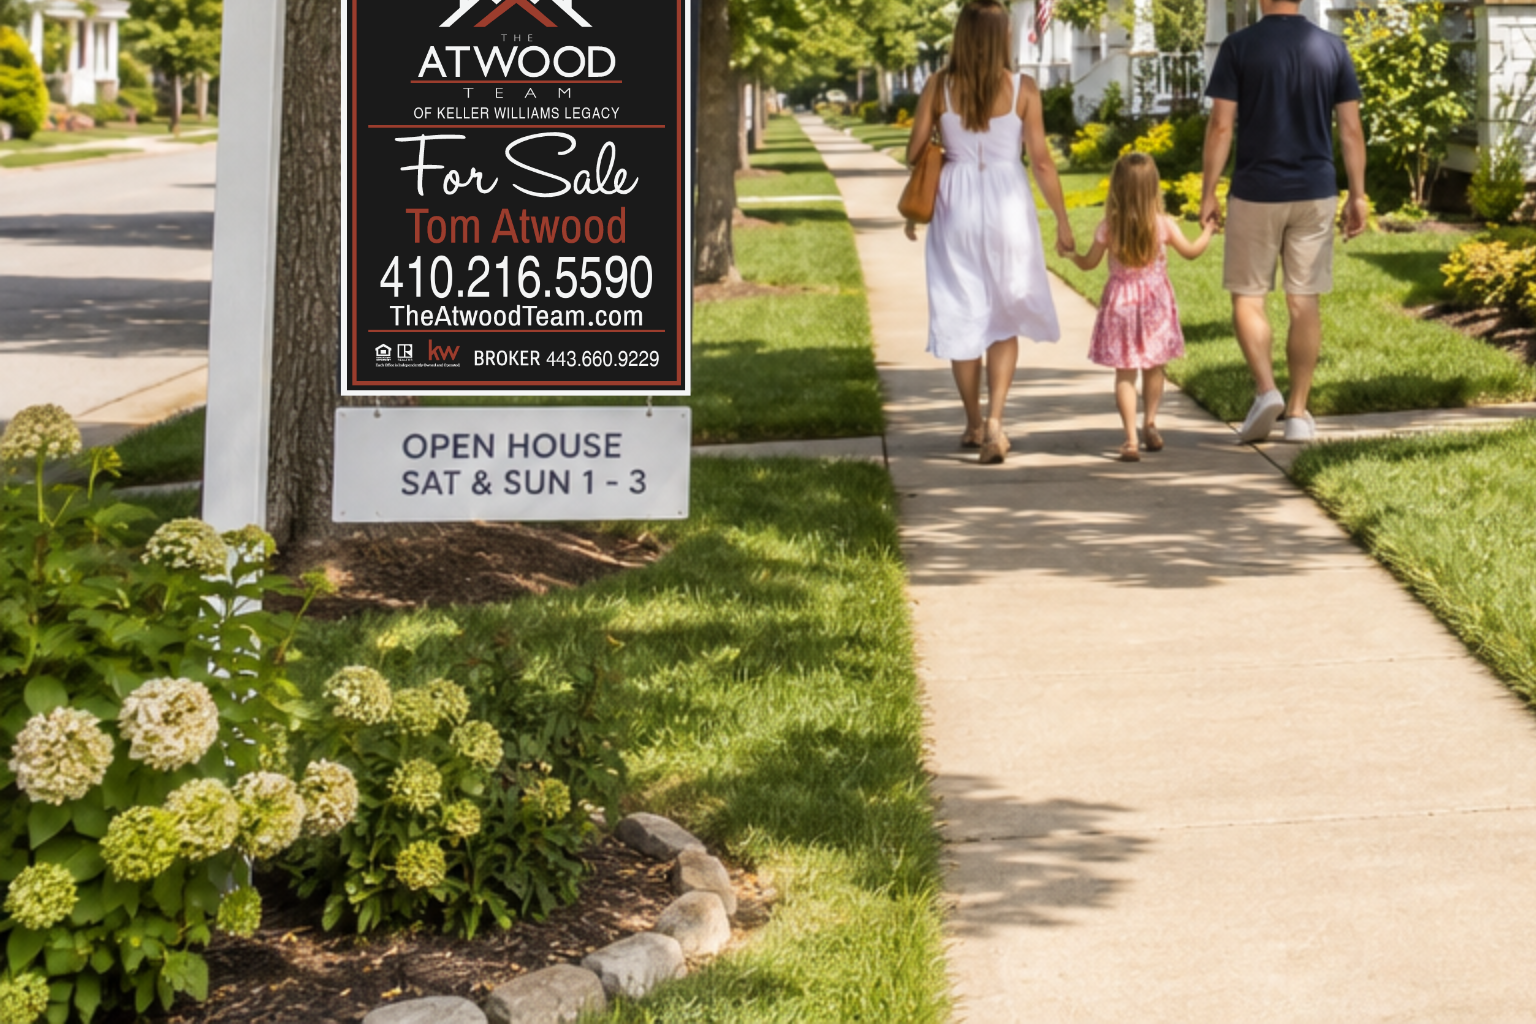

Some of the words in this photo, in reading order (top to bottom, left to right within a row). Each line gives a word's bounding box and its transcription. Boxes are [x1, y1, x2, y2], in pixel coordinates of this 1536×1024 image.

[501, 33, 533, 42] THE
[417, 45, 616, 78] ATWOOD
[462, 87, 572, 99] TEAM
[413, 106, 433, 120] OF
[437, 106, 490, 120] KELLER
[493, 106, 560, 120] WILLIAMS
[564, 106, 620, 120] LEGACY
[394, 133, 499, 197] For
[504, 131, 640, 198] Sale
[405, 208, 480, 244] Tom
[491, 206, 626, 244] Atwood
[379, 254, 653, 299] 410.216.5590
[389, 304, 643, 327] TheAtwoodTeam.com
[428, 339, 461, 361] kw
[474, 349, 541, 367] BROKER
[545, 350, 660, 368] 443.660.9229
[402, 432, 495, 459] OPEN
[507, 432, 623, 459] HOUSE
[400, 470, 461, 496] SAT
[471, 469, 492, 496] &
[503, 469, 570, 495] SUN
[582, 469, 594, 495] 1
[629, 469, 647, 495] 3
